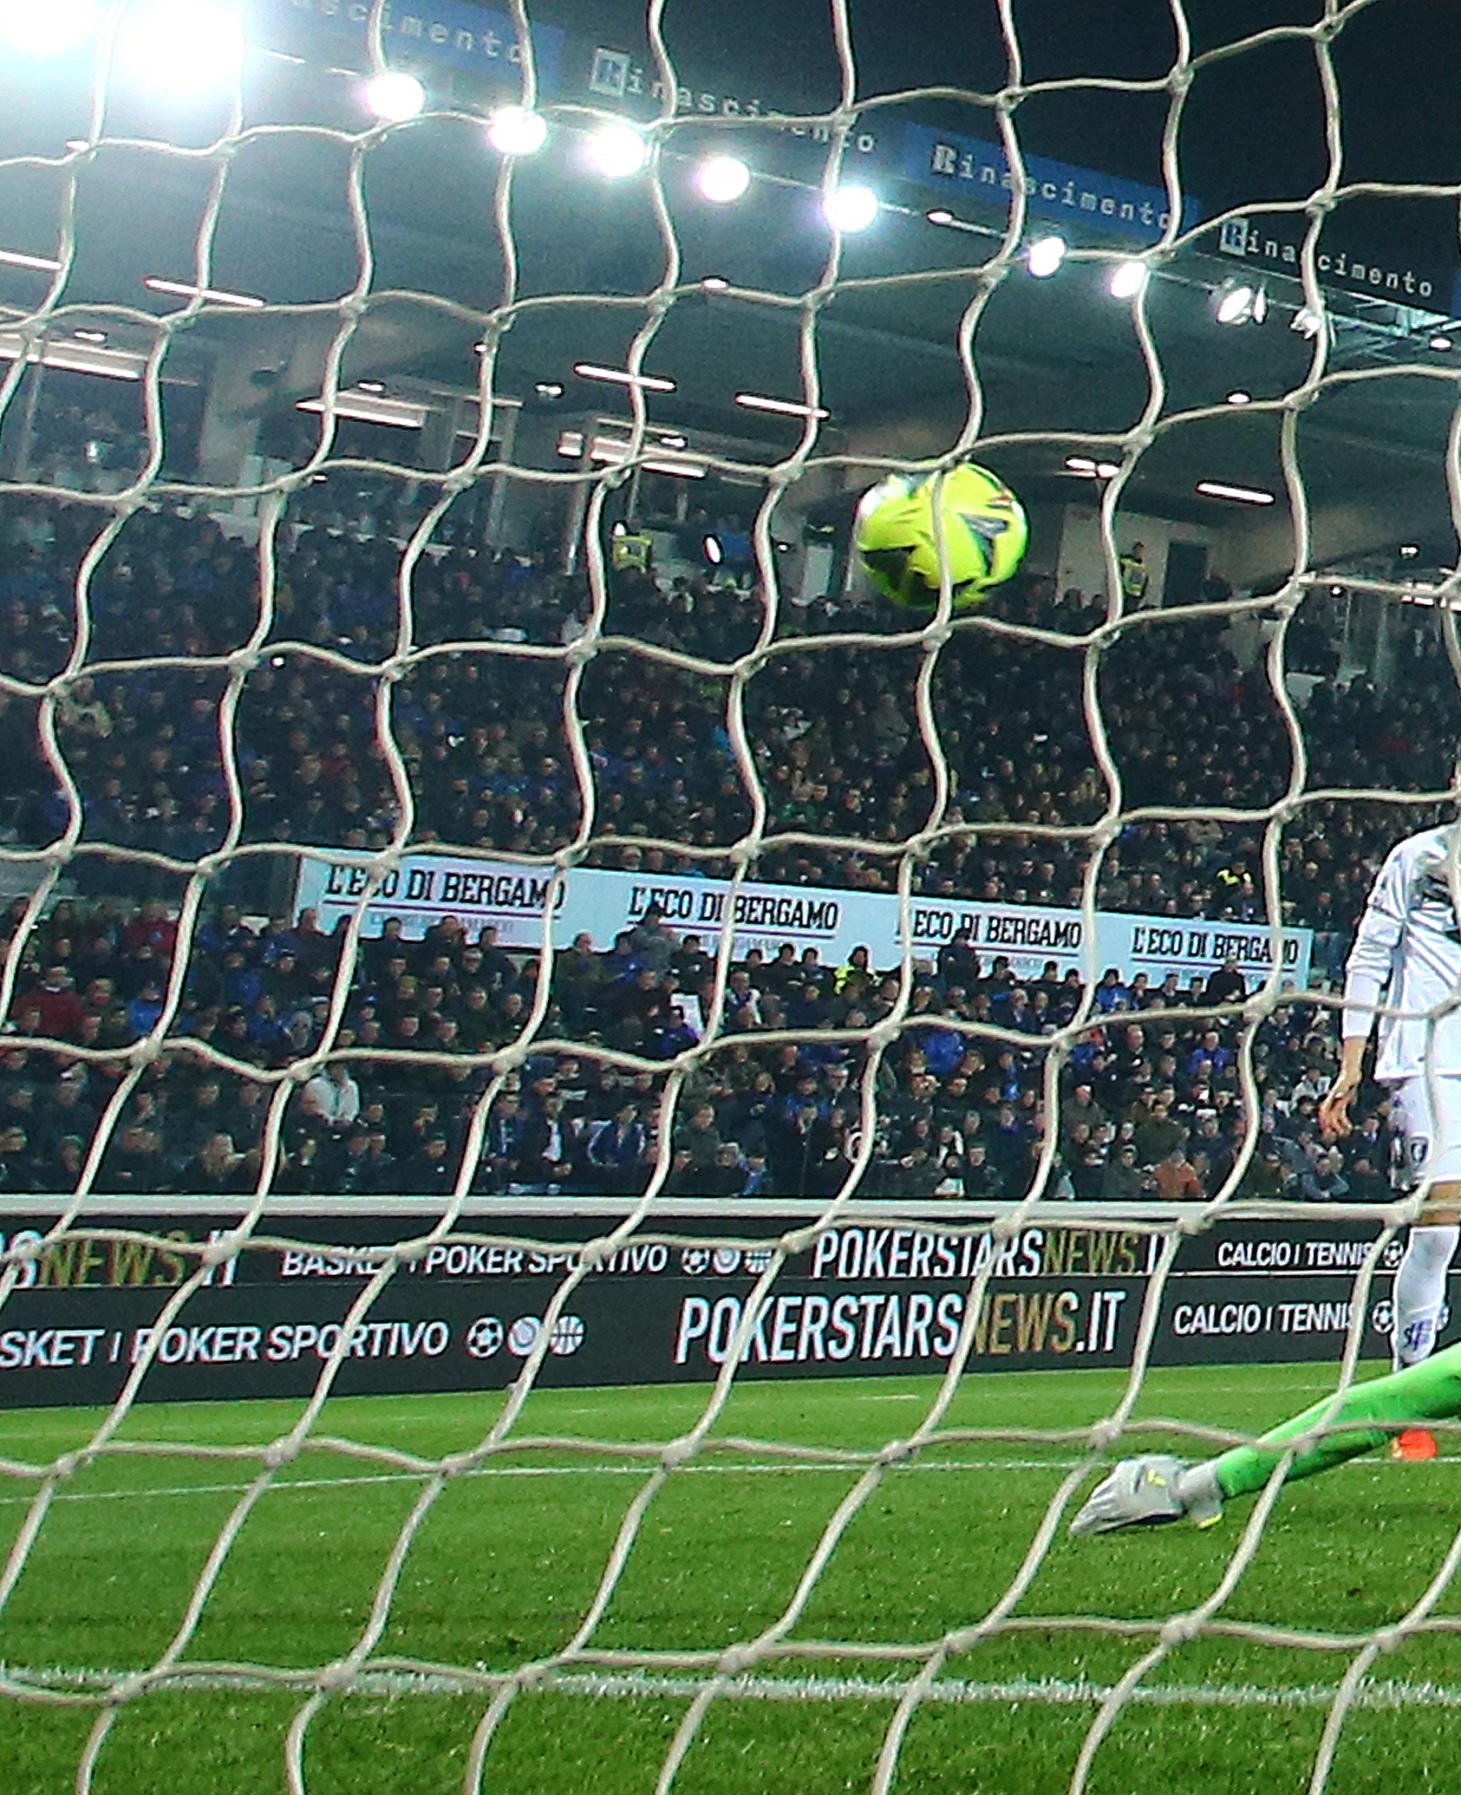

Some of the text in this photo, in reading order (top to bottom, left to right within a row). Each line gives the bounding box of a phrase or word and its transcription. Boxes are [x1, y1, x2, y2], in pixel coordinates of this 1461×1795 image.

[1220, 217, 1433, 297] Rinacimento
[325, 864, 399, 898] L'EO
[406, 869, 435, 901] DI
[628, 886, 839, 930] L'ECO DI BERGAMO
[986, 914, 1083, 949] BERGAMO
[1132, 927, 1299, 965] L'ECO DI BERGAO
[424, 1245, 525, 1274] POKER
[529, 1244, 668, 1273] SPOTIVO
[1217, 1241, 1291, 1267] CALCIO
[1173, 1303, 1261, 1335] CALCIO
[130, 1326, 262, 1364] POKER
[267, 1321, 450, 1362] SPORTIVO
